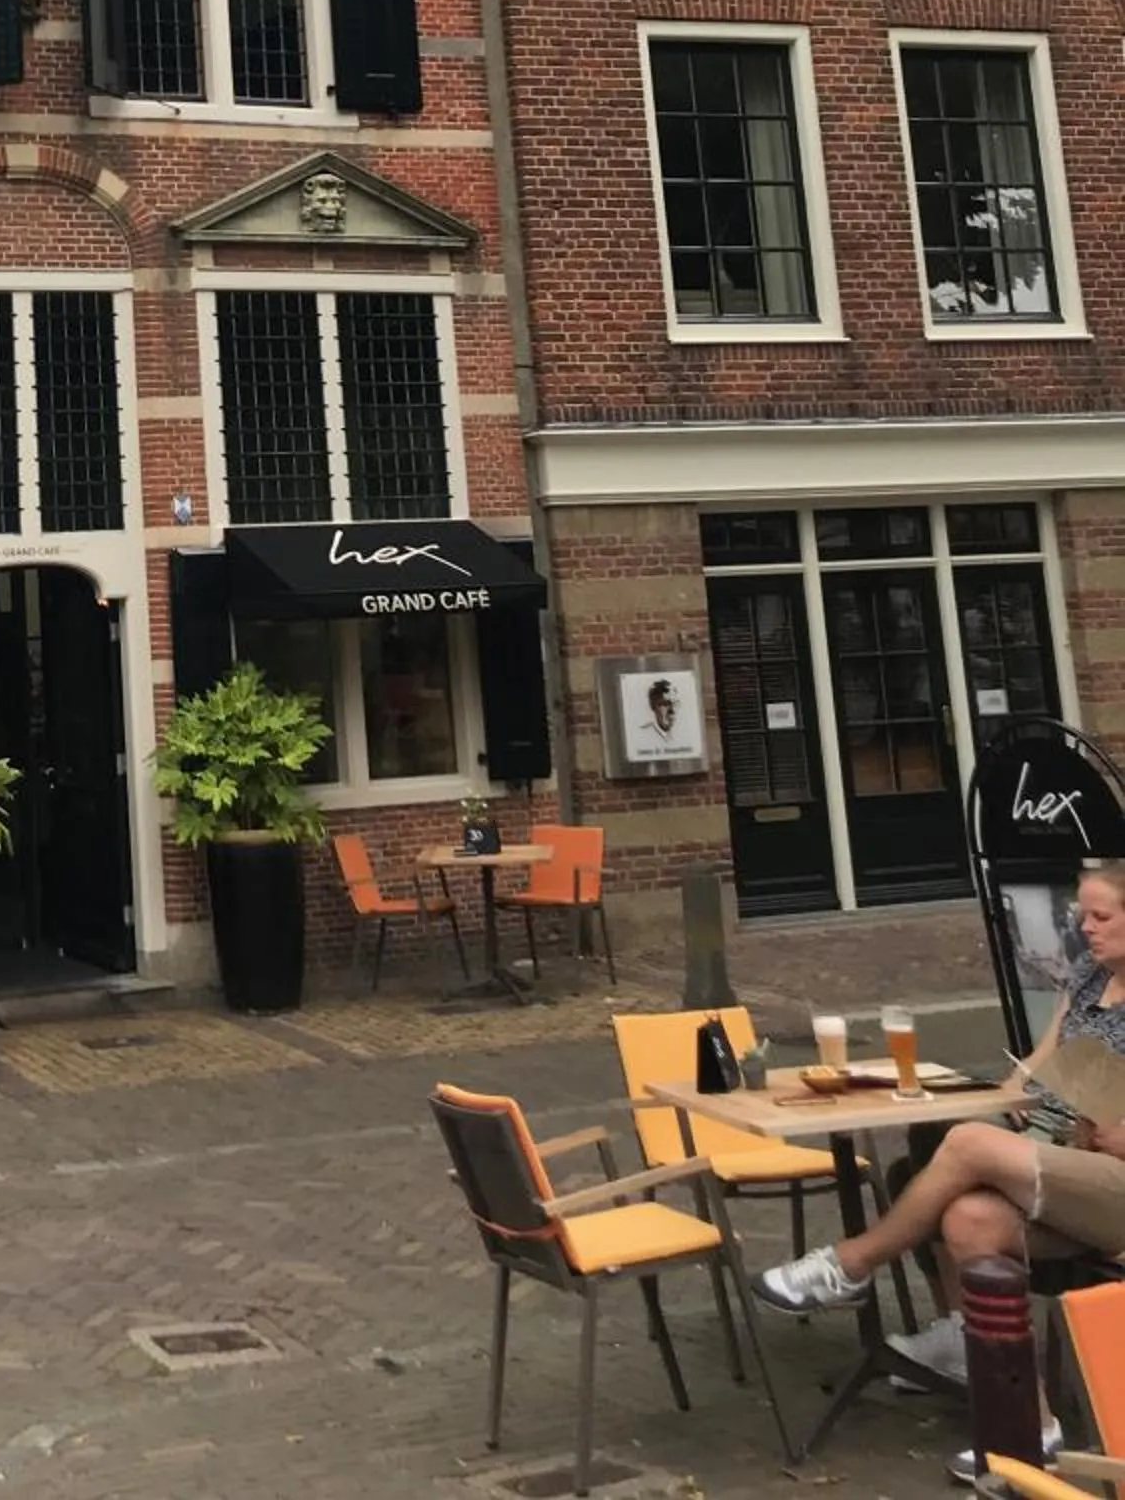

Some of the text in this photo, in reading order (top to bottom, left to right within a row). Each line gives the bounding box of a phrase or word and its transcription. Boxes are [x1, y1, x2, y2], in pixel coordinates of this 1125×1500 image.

[329, 529, 472, 577] hex
[362, 587, 490, 614] GRAND CAFÉ
[1012, 761, 1091, 850] hex
